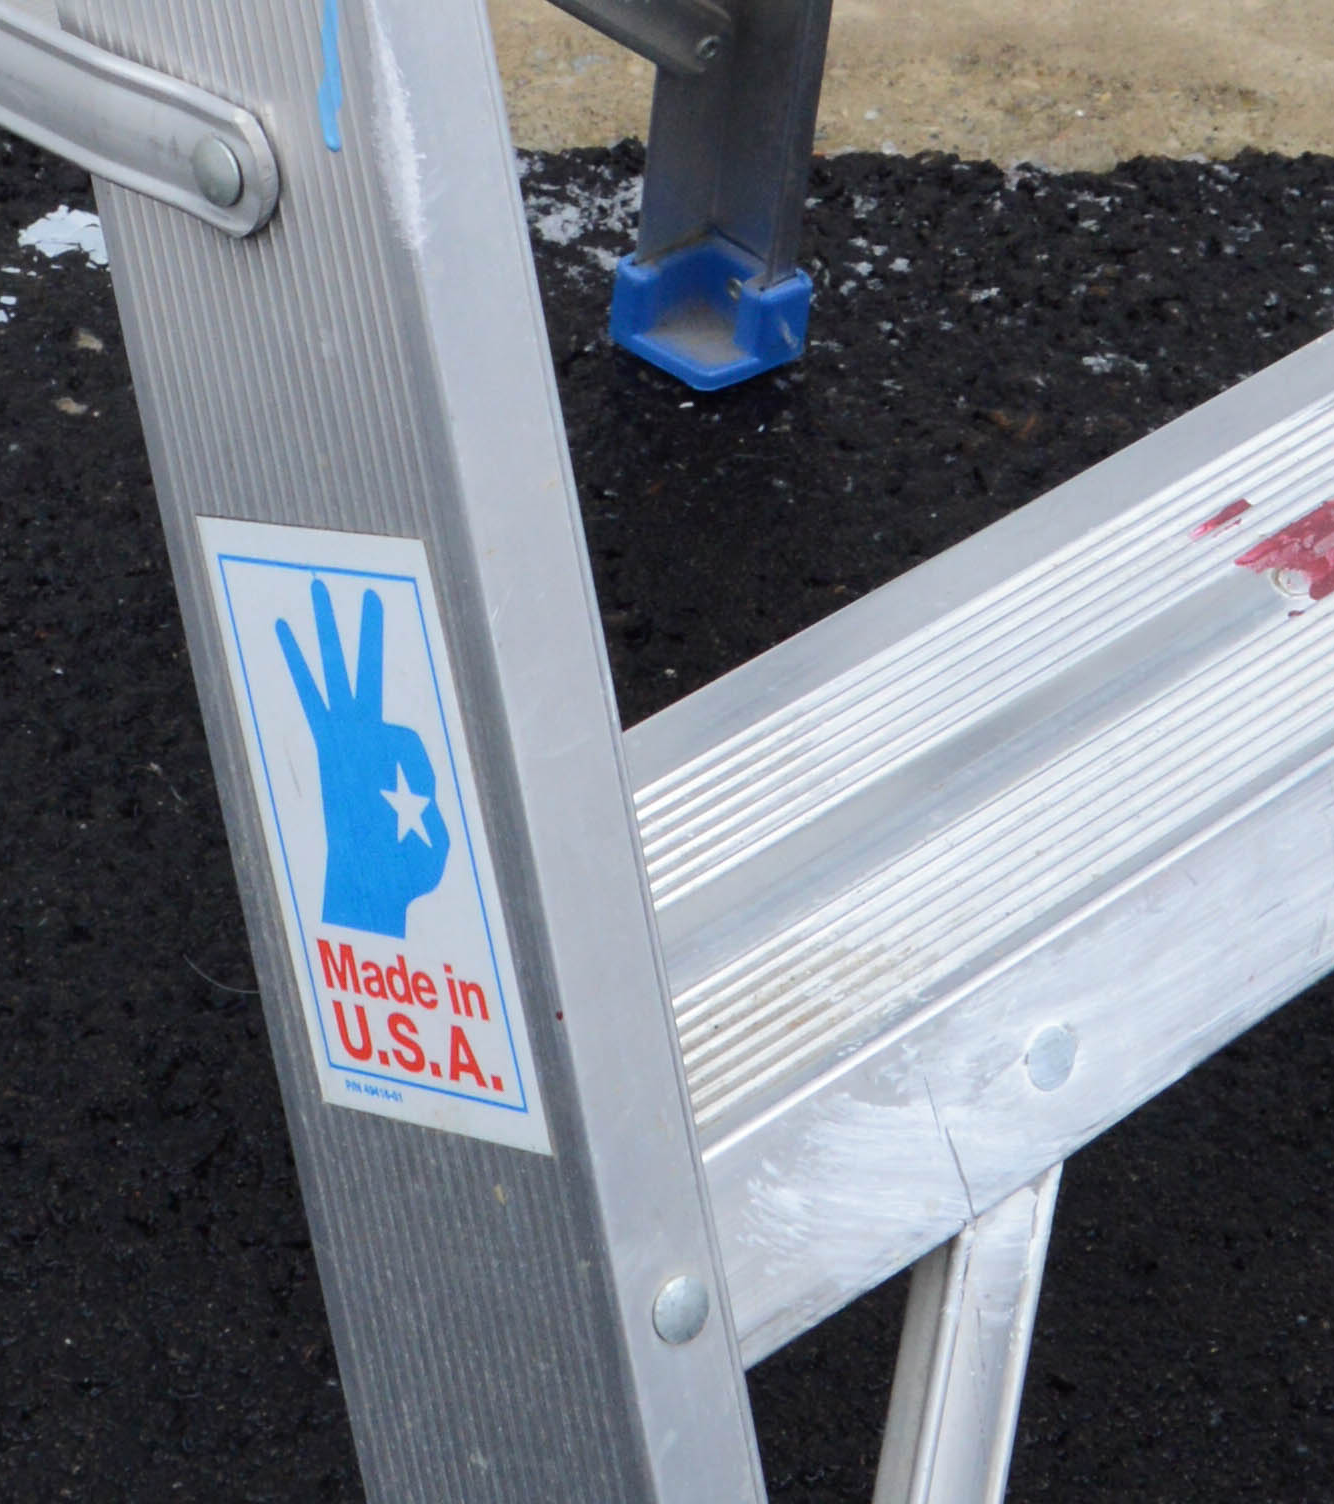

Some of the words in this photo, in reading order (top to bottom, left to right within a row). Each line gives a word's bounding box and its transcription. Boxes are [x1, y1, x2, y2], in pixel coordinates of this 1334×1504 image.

[316, 938, 439, 1011] Made
[443, 963, 491, 1022] in
[332, 1000, 504, 1093] U.S.A.
